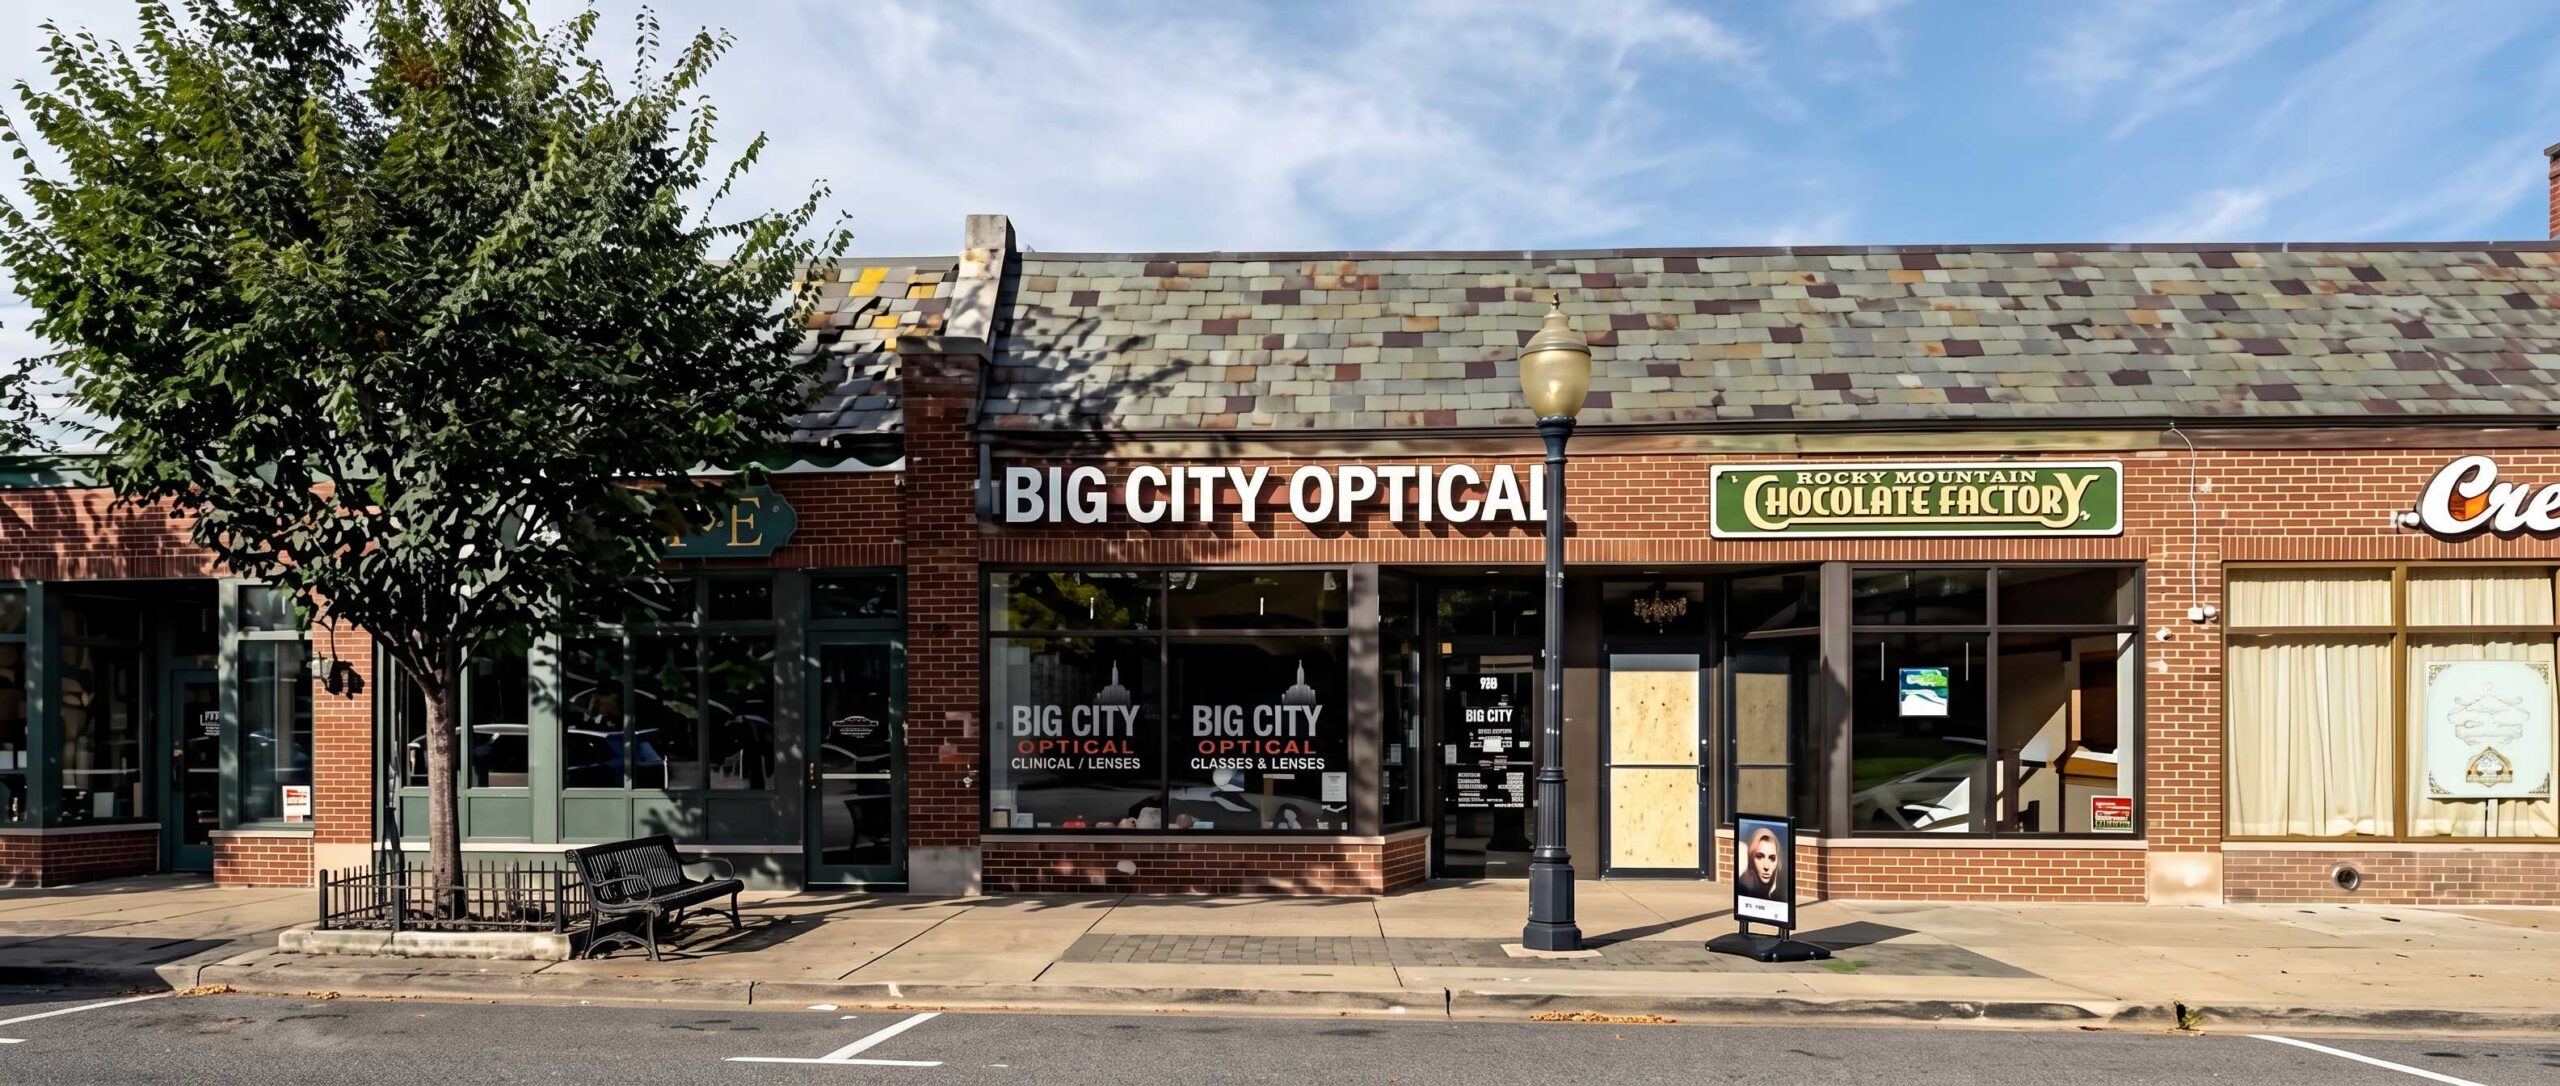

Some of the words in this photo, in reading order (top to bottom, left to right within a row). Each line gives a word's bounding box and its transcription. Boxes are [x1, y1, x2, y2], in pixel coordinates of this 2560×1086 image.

[1797, 471, 1888, 485] ROCKY
[1895, 470, 2037, 484] MOUNTAIN
[1005, 466, 1108, 523] BIG
[1124, 465, 1272, 523] CITY
[1289, 463, 1548, 523] OPTICAL
[1744, 474, 1931, 531] CHOCOLATE
[1938, 472, 2100, 529] FACTORY
[1012, 704, 1063, 737] BIG
[1072, 704, 1140, 737] CITY
[1192, 704, 1244, 737] BIG
[1253, 704, 1323, 737] CITY
[1465, 708, 1485, 722] BIG
[1487, 708, 1513, 722] CITY
[1018, 740, 1135, 754] OPTICAL
[1198, 740, 1317, 754] OPTICAL
[1011, 757, 1075, 769] CLINICAL
[1088, 757, 1141, 769] LENSES
[1257, 757, 1267, 770] &
[1272, 757, 1325, 769] LENSES
